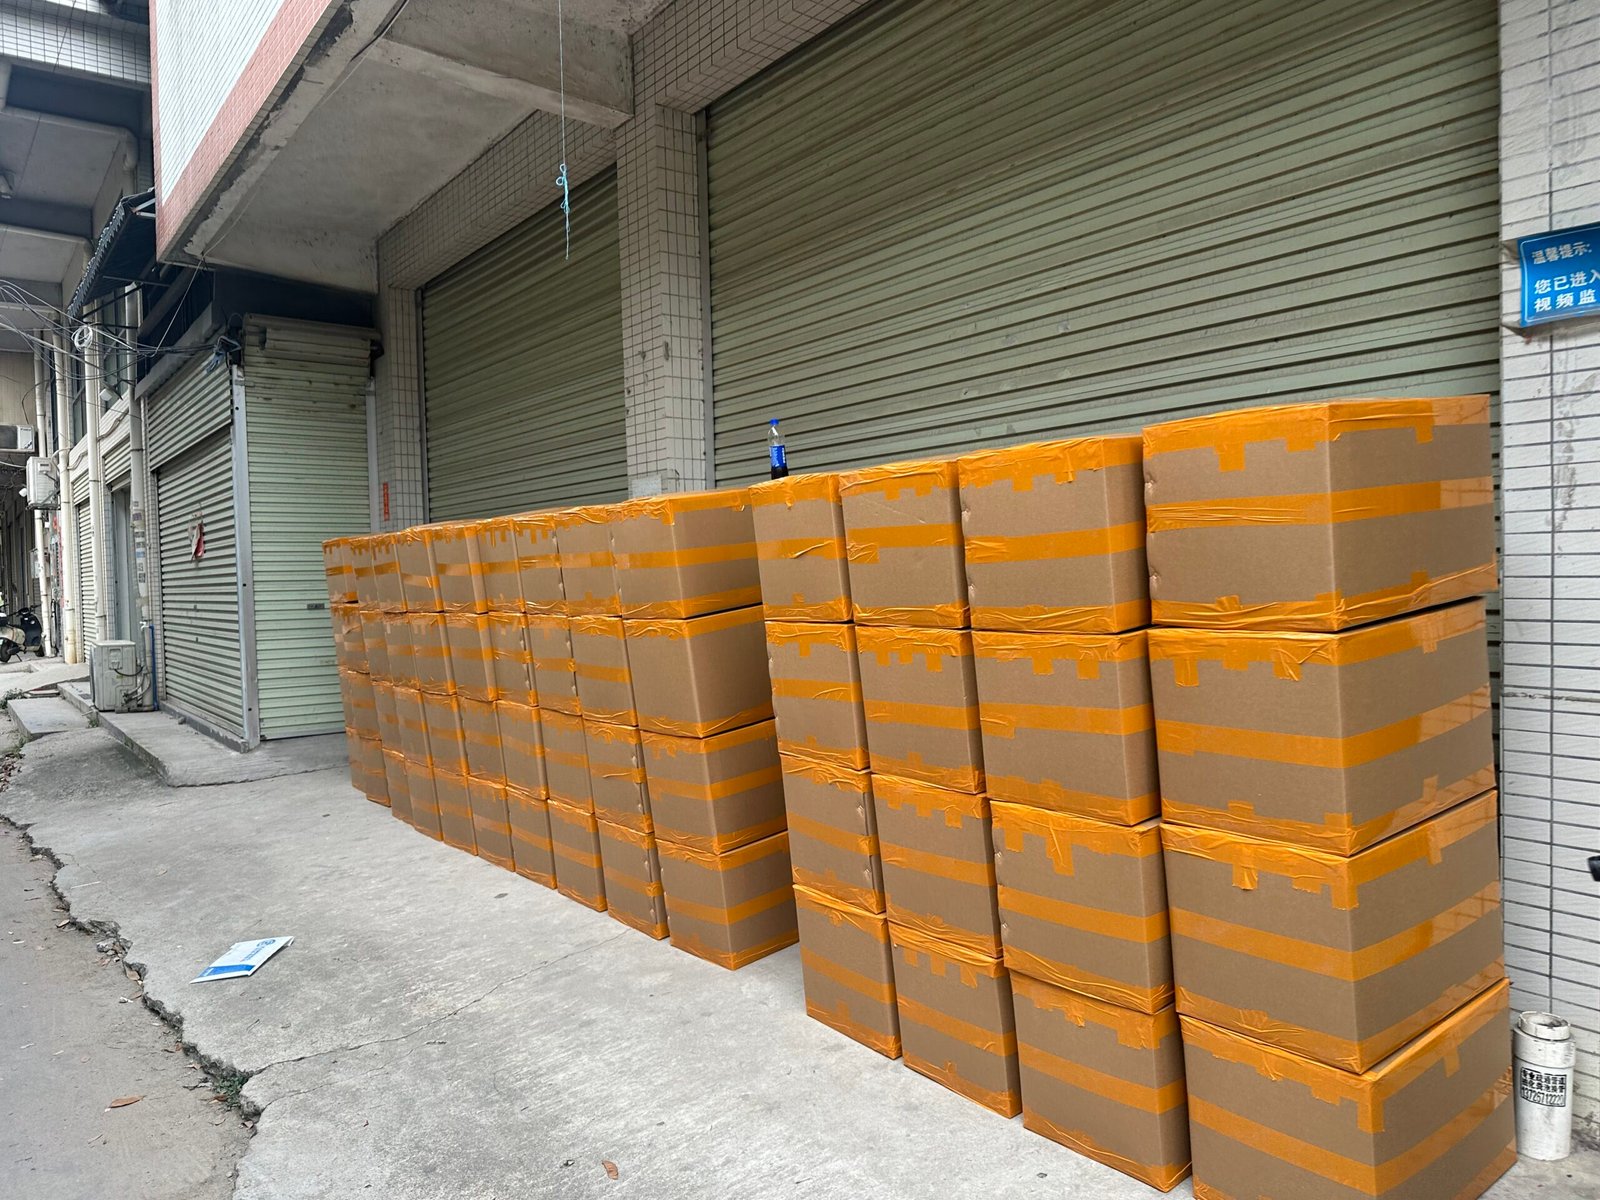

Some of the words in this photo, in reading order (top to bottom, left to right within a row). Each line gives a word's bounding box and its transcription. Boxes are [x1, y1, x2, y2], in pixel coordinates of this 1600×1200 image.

[1534, 269, 1600, 294] 您已进入
[1534, 288, 1597, 312] 视频监
